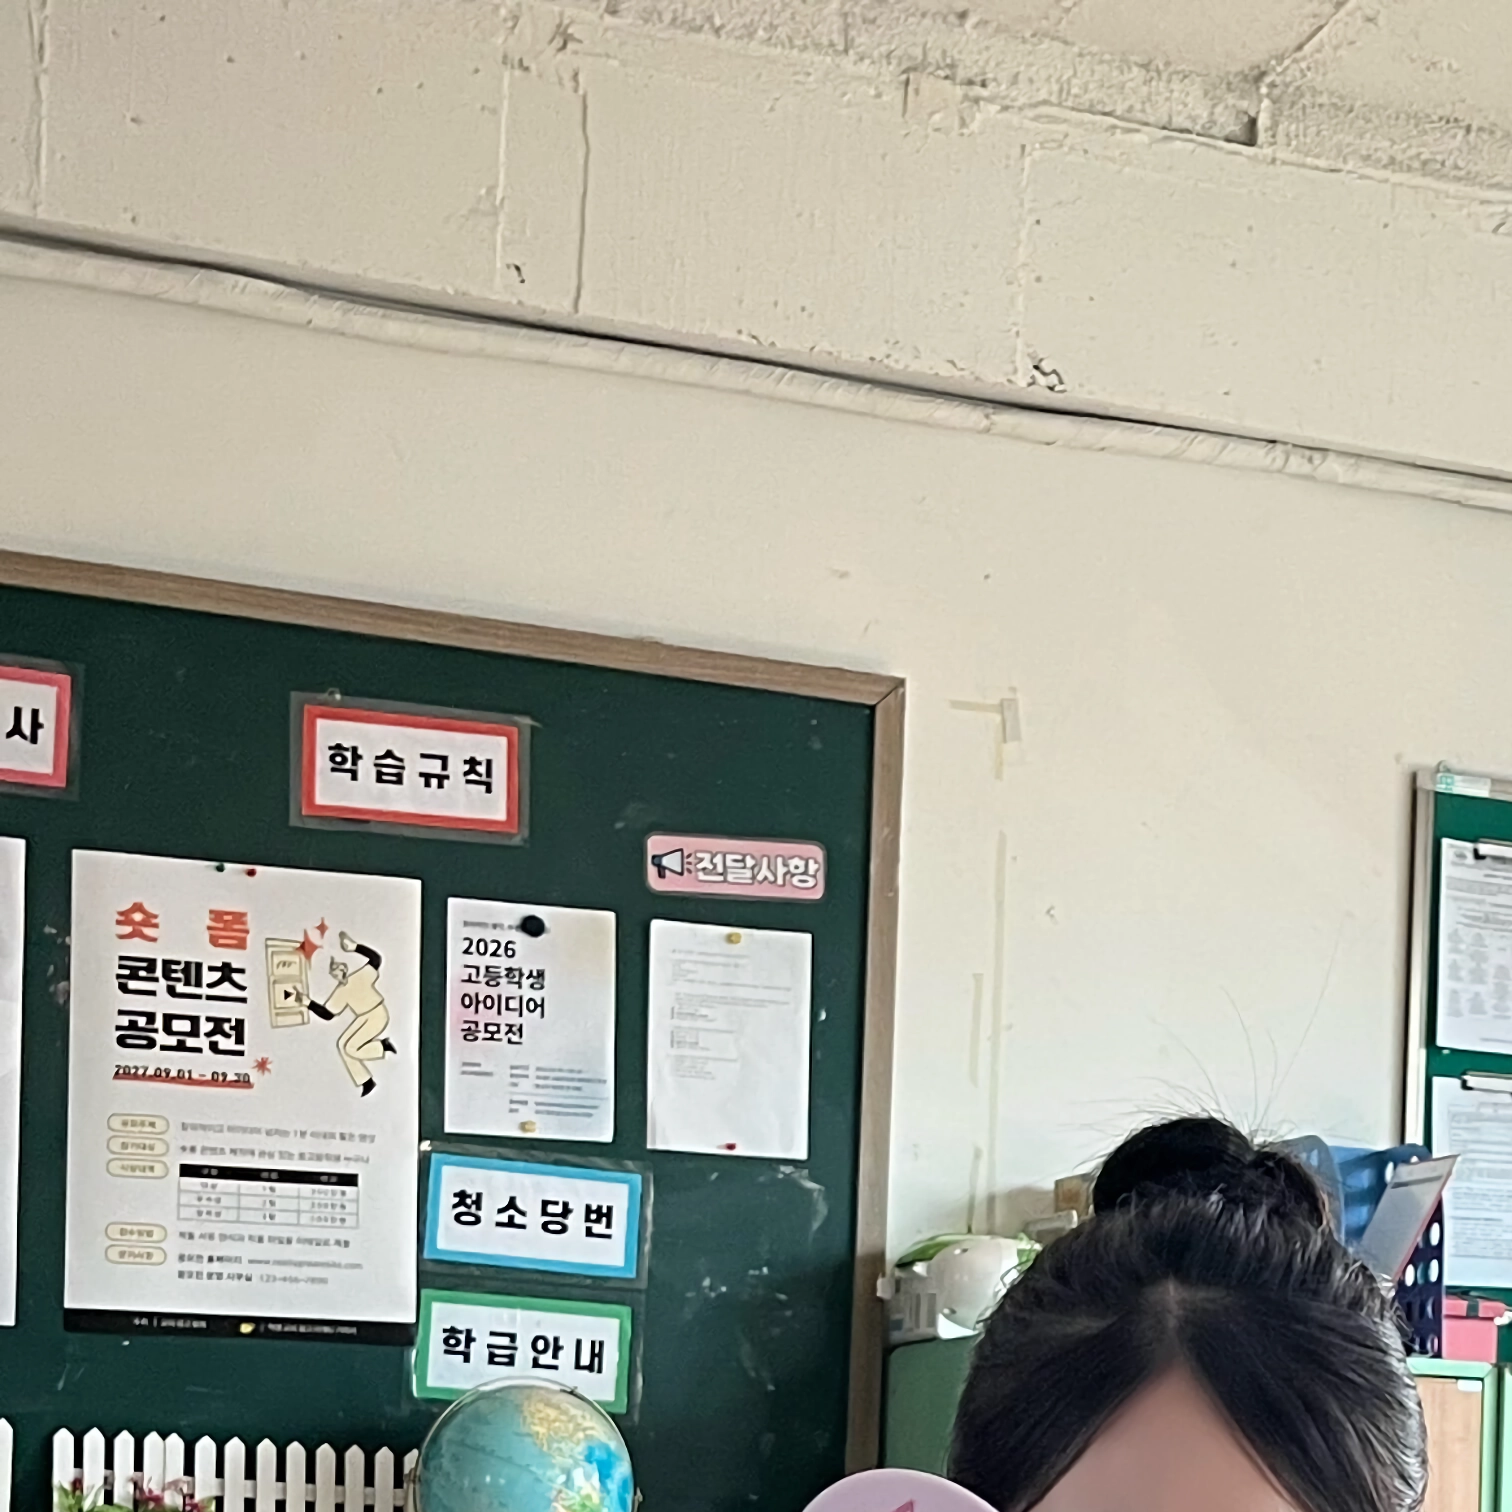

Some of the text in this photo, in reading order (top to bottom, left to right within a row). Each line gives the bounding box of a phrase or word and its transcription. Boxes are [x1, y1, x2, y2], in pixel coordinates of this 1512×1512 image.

[327, 742, 494, 795] 학습규칙
[694, 850, 821, 889] 전달사항
[461, 936, 517, 959] 2026
[115, 955, 248, 1004] 콘텐츠
[461, 963, 546, 991] 고등학생
[460, 992, 546, 1019] 아이디어
[115, 1008, 246, 1057] 공모전
[460, 1019, 524, 1045] 공모전
[451, 1188, 615, 1241] 청소당번
[441, 1325, 605, 1375] 학급안내
